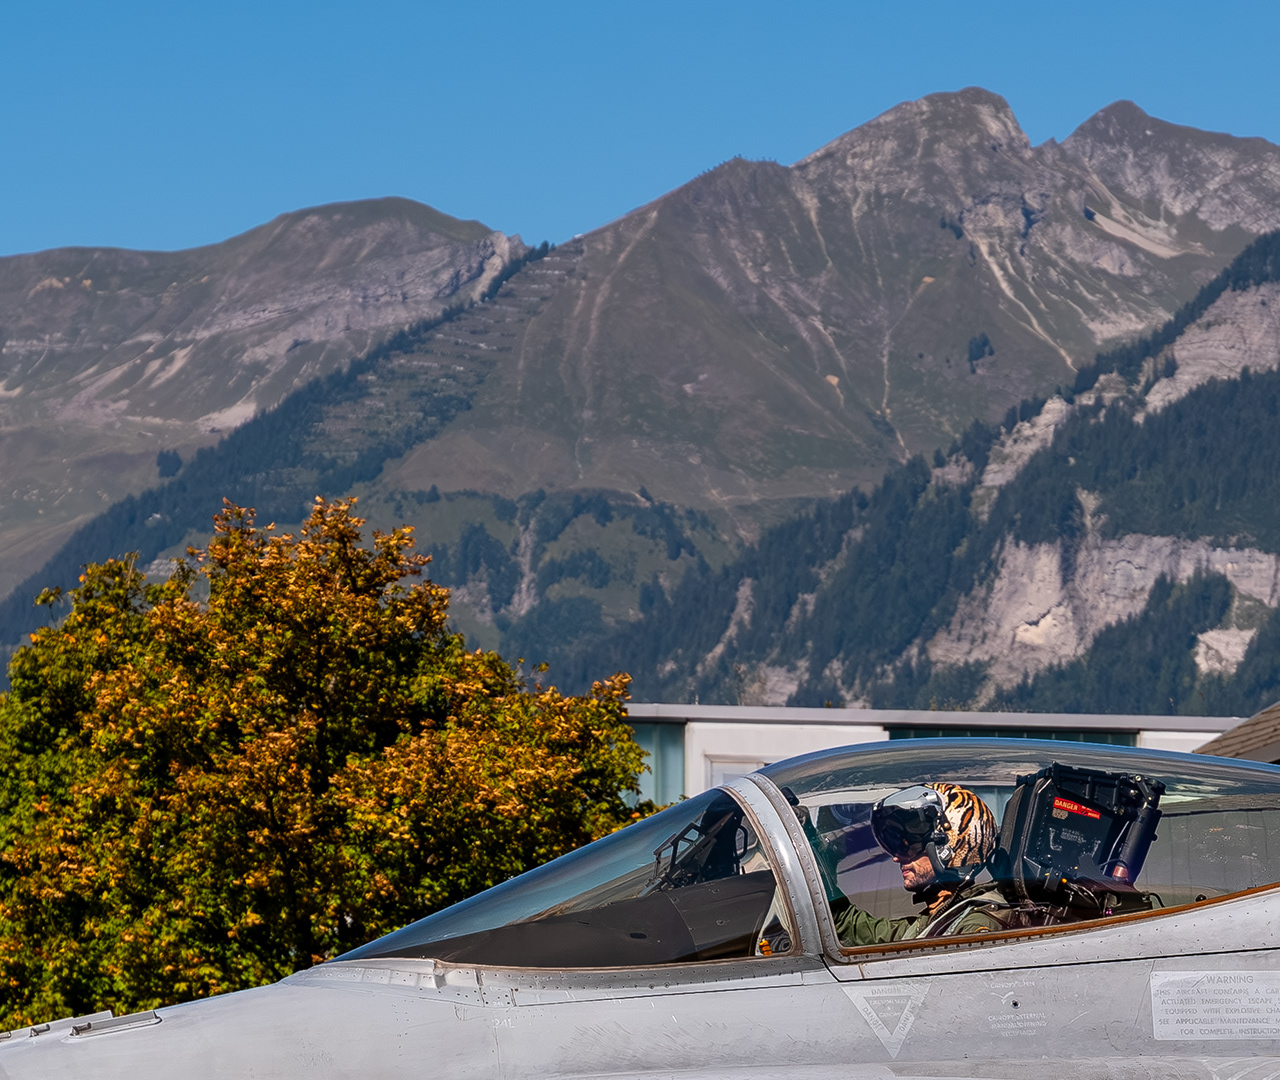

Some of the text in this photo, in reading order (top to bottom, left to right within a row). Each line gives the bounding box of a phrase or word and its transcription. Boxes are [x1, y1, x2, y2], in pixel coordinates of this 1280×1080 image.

[1054, 799, 1079, 811] DANGER
[1206, 975, 1254, 985] WARNING
[1213, 987, 1250, 996] CONTAINS
[1161, 998, 1197, 1006] ACTUATED
[1201, 997, 1243, 1005] EMERGENCY
[1248, 997, 1272, 1005] ESCAPE
[1165, 1008, 1198, 1016] EQUIPPED
[1203, 1007, 1221, 1015] WITH
[1225, 1007, 1261, 1015] EXPLOSIVE
[1158, 1018, 1170, 1026] SEE
[1175, 1018, 1215, 1026] APPLICABLE
[1180, 1028, 1195, 1036] FOR
[1199, 1028, 1234, 1036] COMPLETE
